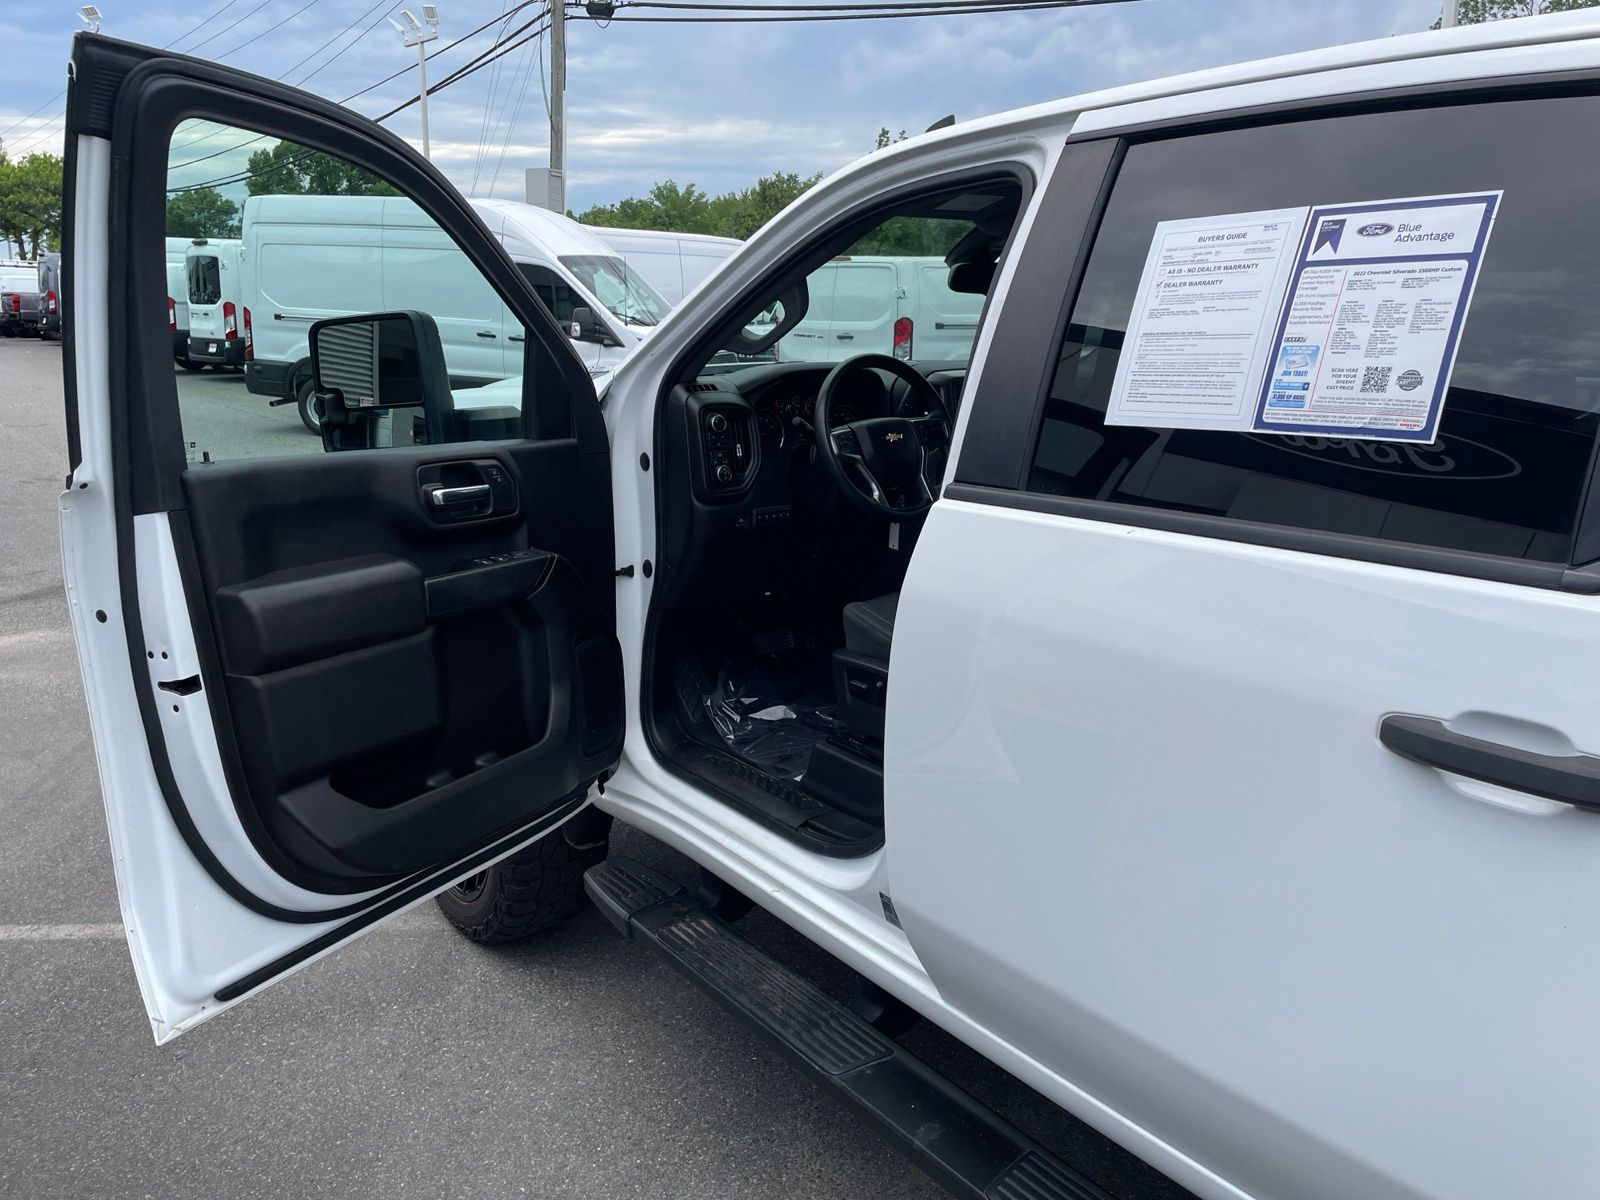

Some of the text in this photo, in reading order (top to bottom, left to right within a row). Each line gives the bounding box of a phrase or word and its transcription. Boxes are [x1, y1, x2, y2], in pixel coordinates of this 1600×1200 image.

[1362, 225, 1386, 236] Ford
[1397, 223, 1422, 233] Blue
[1198, 232, 1248, 243] BUYERS GUIDE
[1394, 231, 1455, 243] Advantage
[1198, 265, 1222, 273] DEALER
[1223, 263, 1260, 272] WARRANTY
[1188, 279, 1223, 287] WARRANTY
